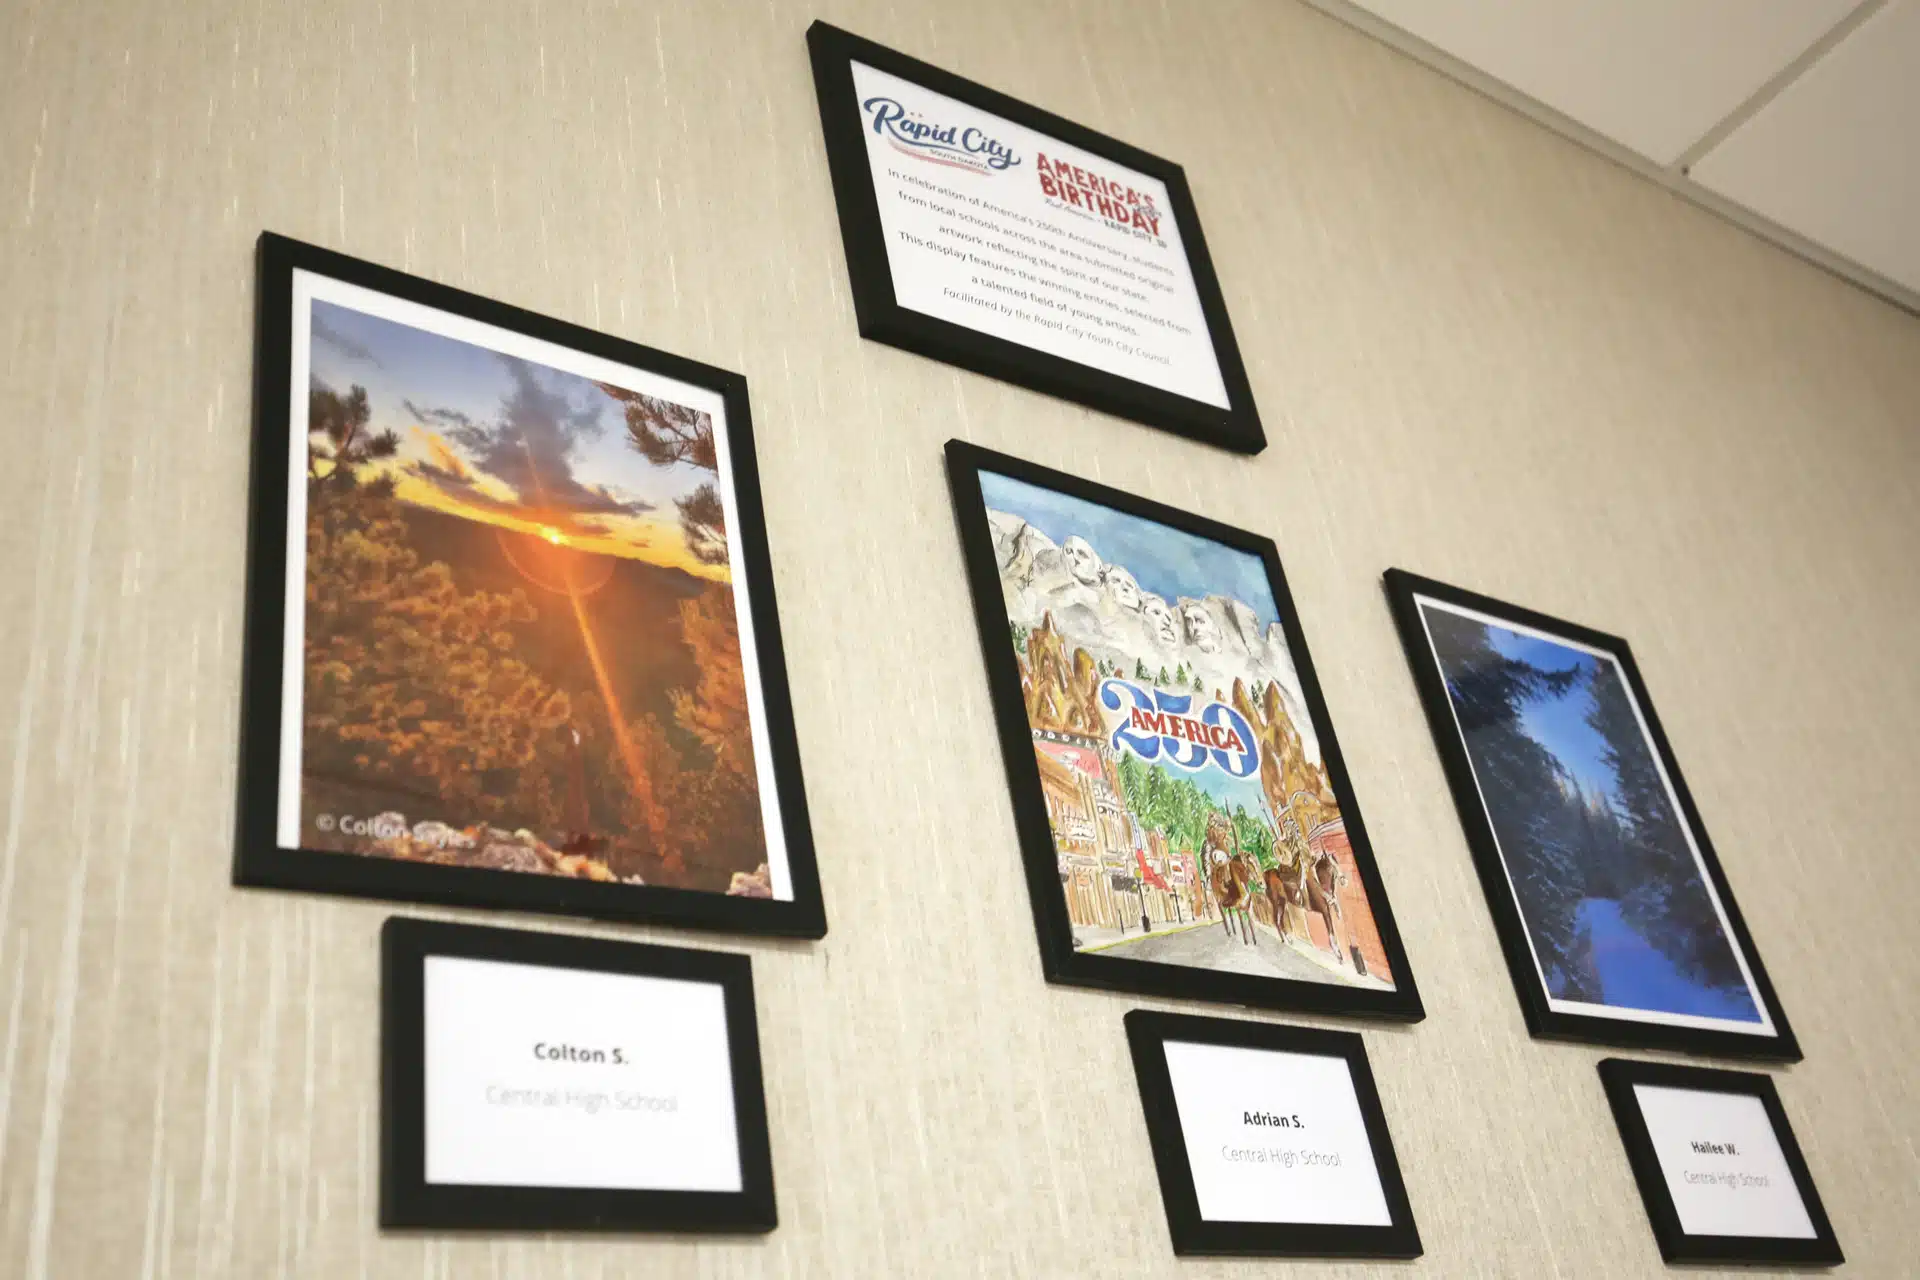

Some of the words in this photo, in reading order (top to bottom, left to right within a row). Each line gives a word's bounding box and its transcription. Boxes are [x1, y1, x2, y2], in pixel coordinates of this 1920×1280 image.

[863, 97, 957, 148] Rapid
[962, 127, 1022, 170] City
[888, 168, 900, 179] In
[902, 174, 966, 202] celebration
[969, 198, 980, 206] of
[983, 201, 1035, 226] America's
[1036, 152, 1156, 210] AMERICA'S
[1038, 172, 1160, 236] BIRTHDAY
[899, 190, 927, 207] from
[930, 201, 956, 217] local
[959, 212, 1000, 233] schools
[1002, 228, 1037, 245] across
[1039, 240, 1057, 252] the
[1059, 248, 1082, 261] area
[1085, 256, 1136, 281] submitted
[939, 225, 983, 245] artwork
[986, 241, 1038, 267] reflecting
[1039, 258, 1058, 271] the
[1060, 266, 1086, 282] spirit
[1089, 276, 1099, 286] of
[1102, 281, 1119, 293] our
[899, 230, 924, 247] This
[926, 240, 967, 262] display
[969, 253, 1016, 276] features
[1019, 270, 1037, 283] the
[1039, 278, 1082, 300] winning
[1124, 306, 1165, 327] selected
[1167, 320, 1192, 335] from
[971, 276, 979, 284] a
[981, 278, 1027, 300] talented
[1030, 291, 1054, 308] field
[1056, 302, 1067, 313] of
[1070, 307, 1103, 327] young
[943, 287, 997, 312] Facilitated
[1000, 303, 1013, 318] by
[1015, 308, 1031, 322] the
[1034, 314, 1063, 331] Rapid
[1066, 324, 1084, 340] City
[1086, 331, 1114, 348] Youth
[1116, 340, 1133, 356] City
[1101, 679, 1259, 777] 250
[1131, 706, 1245, 752] AMERICA
[534, 1042, 606, 1063] Colton
[612, 1048, 629, 1065] S.
[485, 1085, 558, 1107] Central
[564, 1088, 610, 1115] High
[614, 1090, 679, 1113] School
[1244, 1111, 1290, 1127] Adrian
[1292, 1114, 1305, 1129] S.
[1222, 1144, 1268, 1163] Central
[1269, 1147, 1299, 1168] High
[1300, 1149, 1342, 1167] School
[1691, 1141, 1725, 1155] Hailee
[1725, 1143, 1740, 1156] W.
[1683, 1169, 1717, 1185] Central
[1718, 1172, 1739, 1190] High
[1739, 1172, 1769, 1188] School
